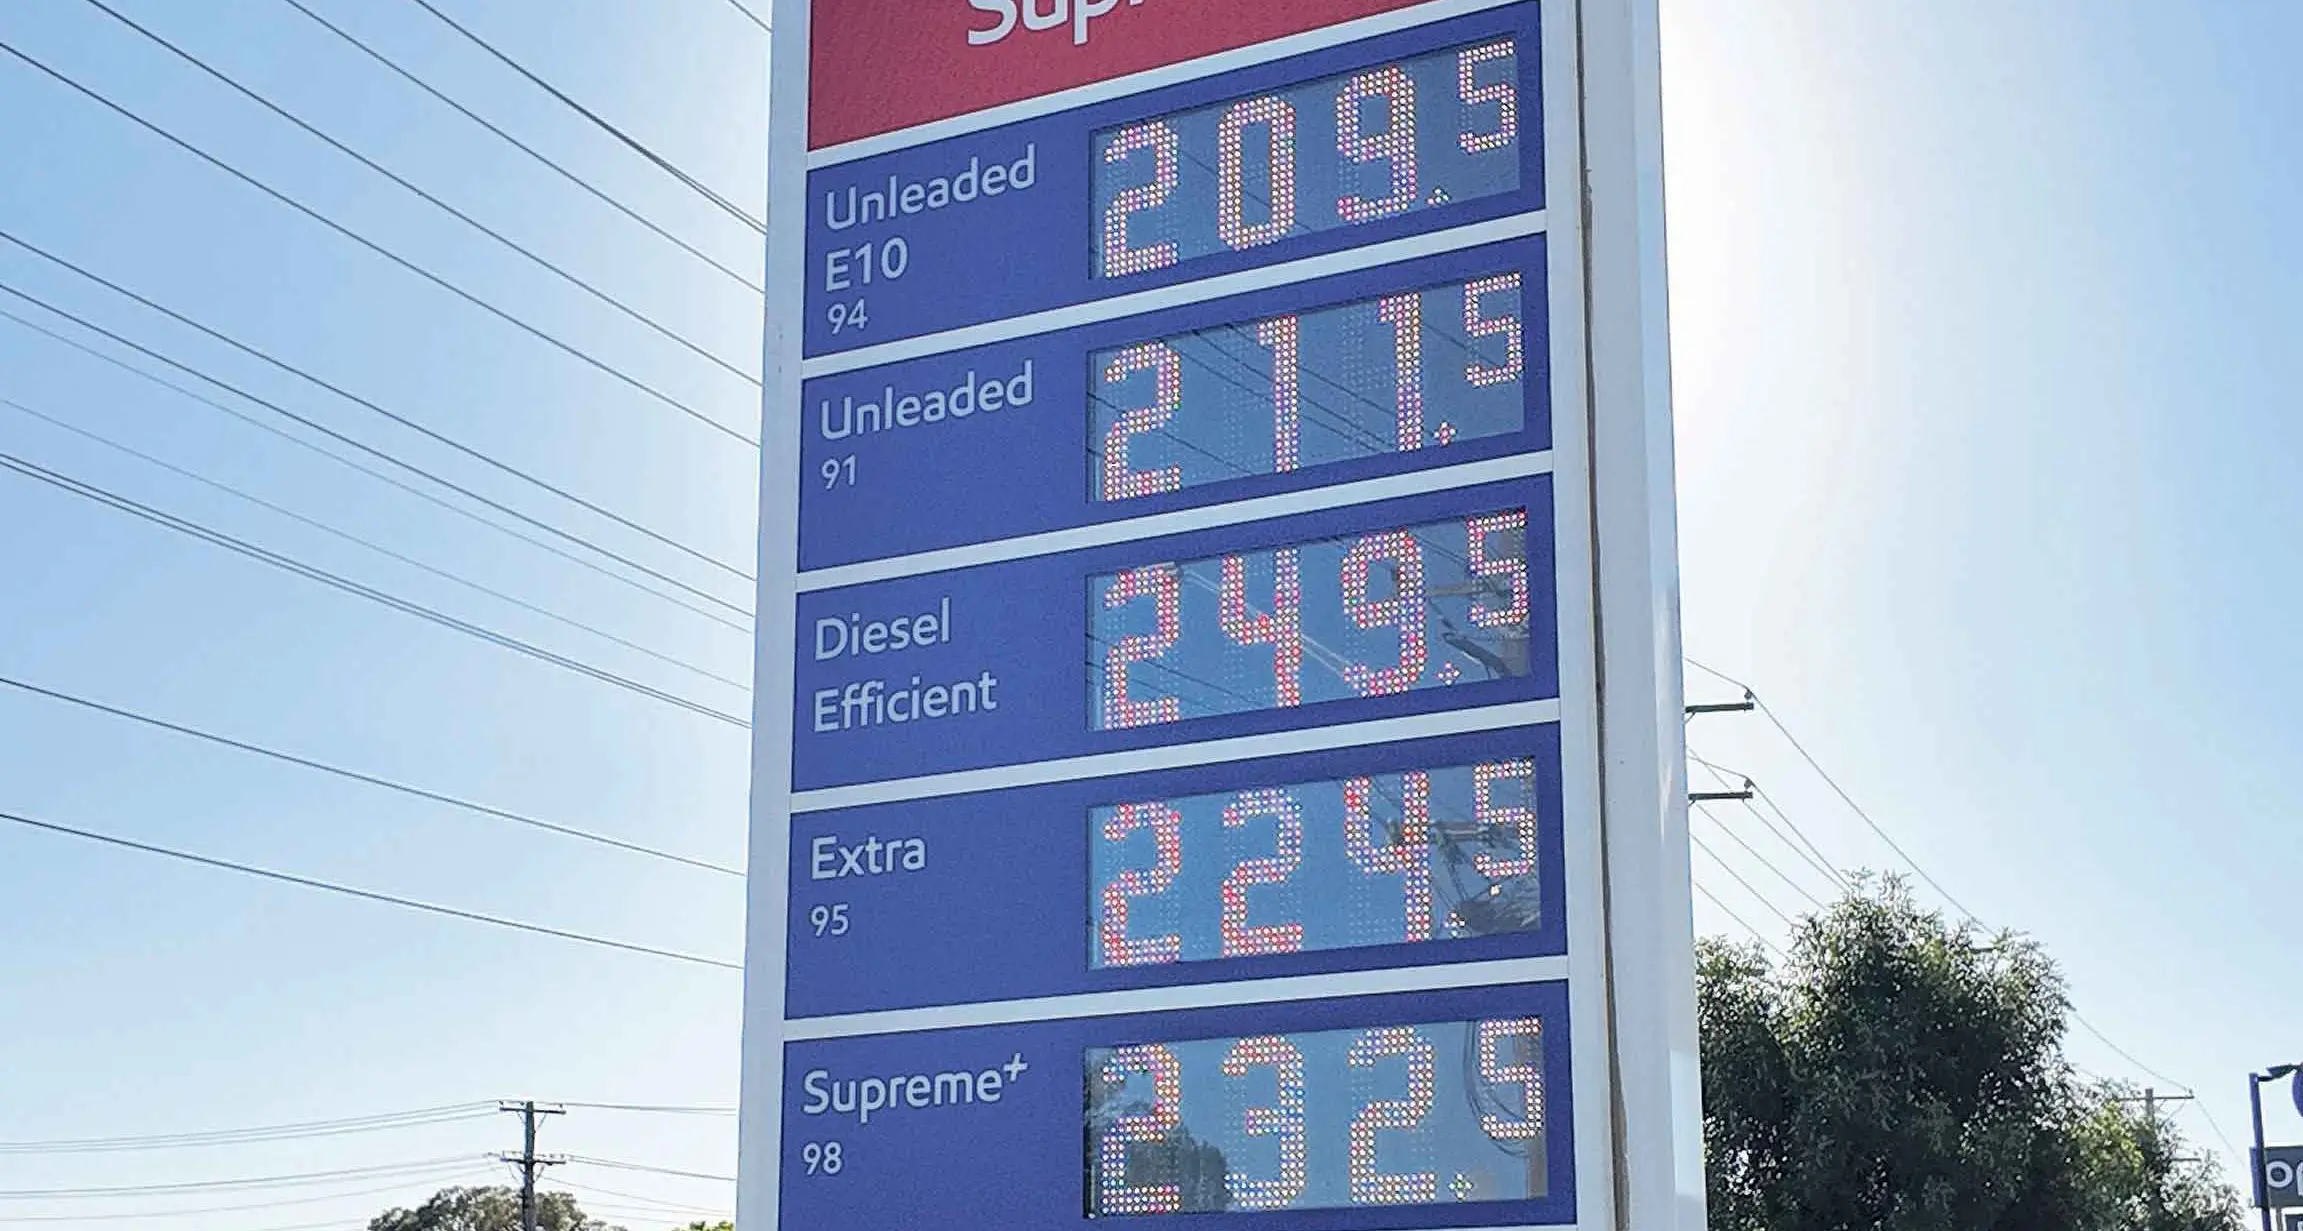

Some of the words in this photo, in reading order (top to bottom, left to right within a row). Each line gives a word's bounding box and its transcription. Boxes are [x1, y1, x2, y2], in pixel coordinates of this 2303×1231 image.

[967, 0, 1143, 45] Sup
[825, 143, 1036, 230] Unleaded
[1104, 40, 1518, 279] 209.5
[825, 236, 908, 293] E10
[827, 299, 869, 335] 94
[821, 359, 1033, 440] Unleaded
[1104, 272, 1524, 502] 211.5
[821, 454, 856, 490] 91
[815, 597, 949, 661] Diesel
[1103, 505, 1529, 730] 249.5
[814, 671, 997, 732] Efficient
[811, 836, 926, 880] Extra
[1101, 756, 1537, 967] 224.5
[810, 903, 849, 937] 95
[803, 1053, 1028, 1123] Supreme+
[1099, 1014, 1545, 1214] 232.5
[803, 1141, 842, 1175] 98
